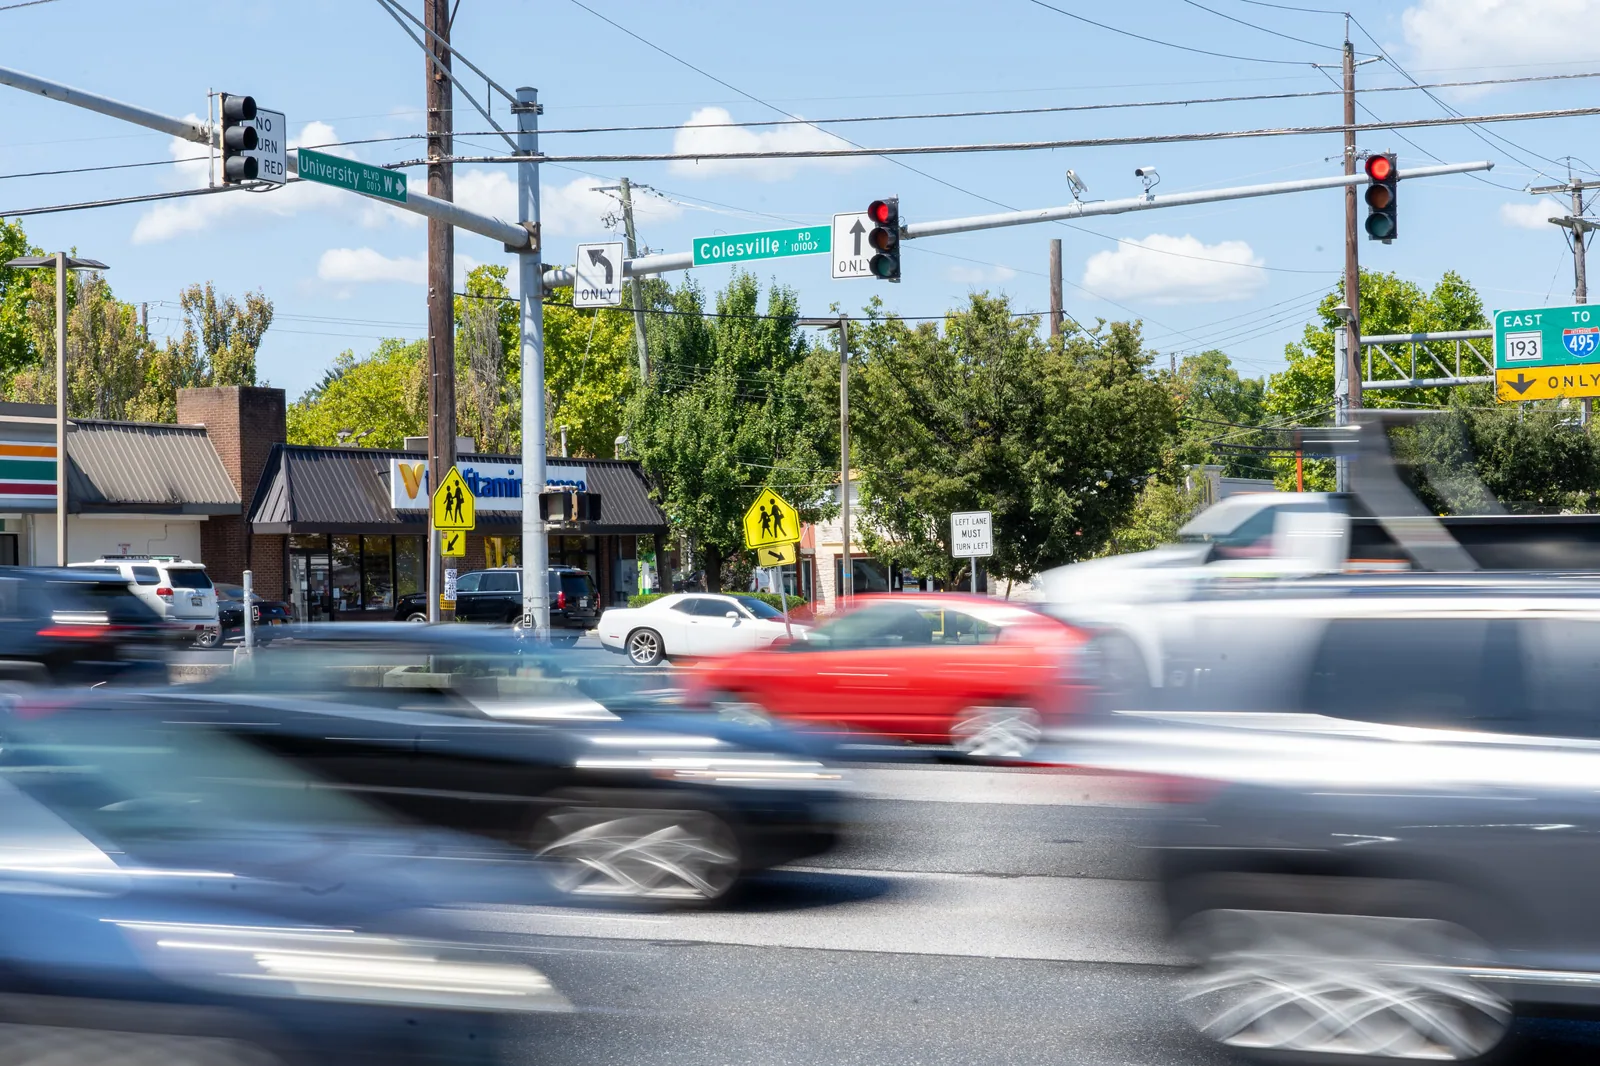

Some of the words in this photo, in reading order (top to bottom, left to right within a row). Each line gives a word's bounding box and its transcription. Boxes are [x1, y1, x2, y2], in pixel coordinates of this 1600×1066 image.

[256, 116, 272, 132] NO
[257, 137, 278, 154] URN
[264, 159, 284, 176] RED
[300, 155, 360, 189] University
[363, 169, 380, 181] BLVD
[383, 175, 393, 193] W
[798, 231, 811, 241] RD
[700, 236, 780, 259] Colesville
[581, 287, 615, 300] ONLY
[1503, 313, 1543, 327] EAST
[1571, 310, 1591, 323] TO
[1510, 340, 1537, 357] 193
[1569, 334, 1594, 352] 495
[1548, 373, 1600, 389] ONLY
[955, 518, 969, 526] LEFT
[972, 517, 987, 526] LANE
[961, 529, 981, 538] MUST
[956, 543, 971, 551] TURN
[973, 542, 989, 550] LEFT
